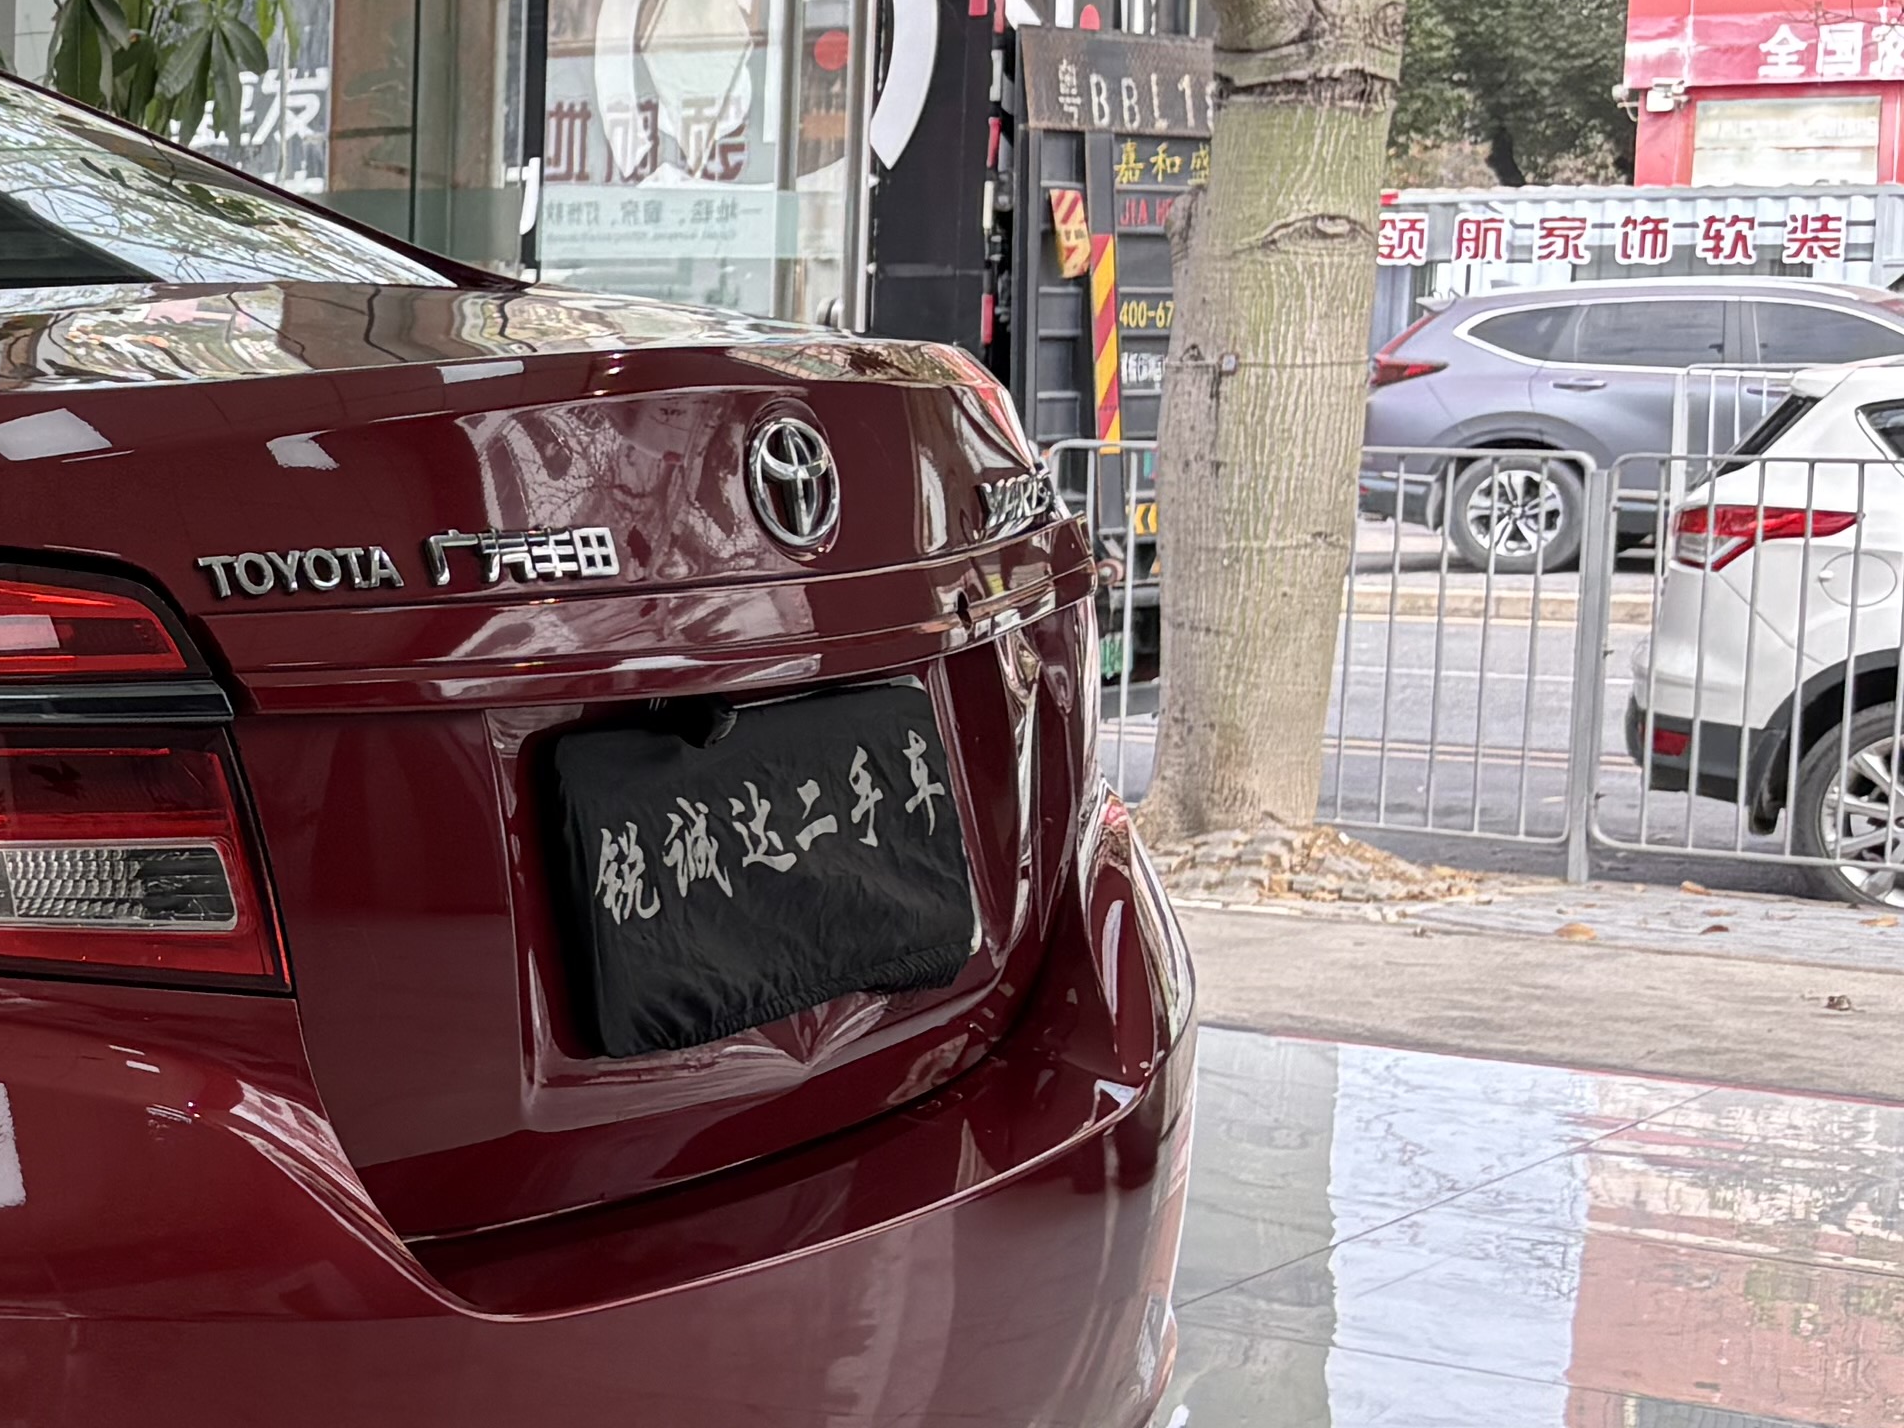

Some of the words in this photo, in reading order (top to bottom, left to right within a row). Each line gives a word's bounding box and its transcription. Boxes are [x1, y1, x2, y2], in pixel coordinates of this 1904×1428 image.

[1378, 212, 1847, 264] 领航家饰软装
[197, 545, 404, 599] TOYOTA
[595, 728, 946, 925] 锐诚达二手车
